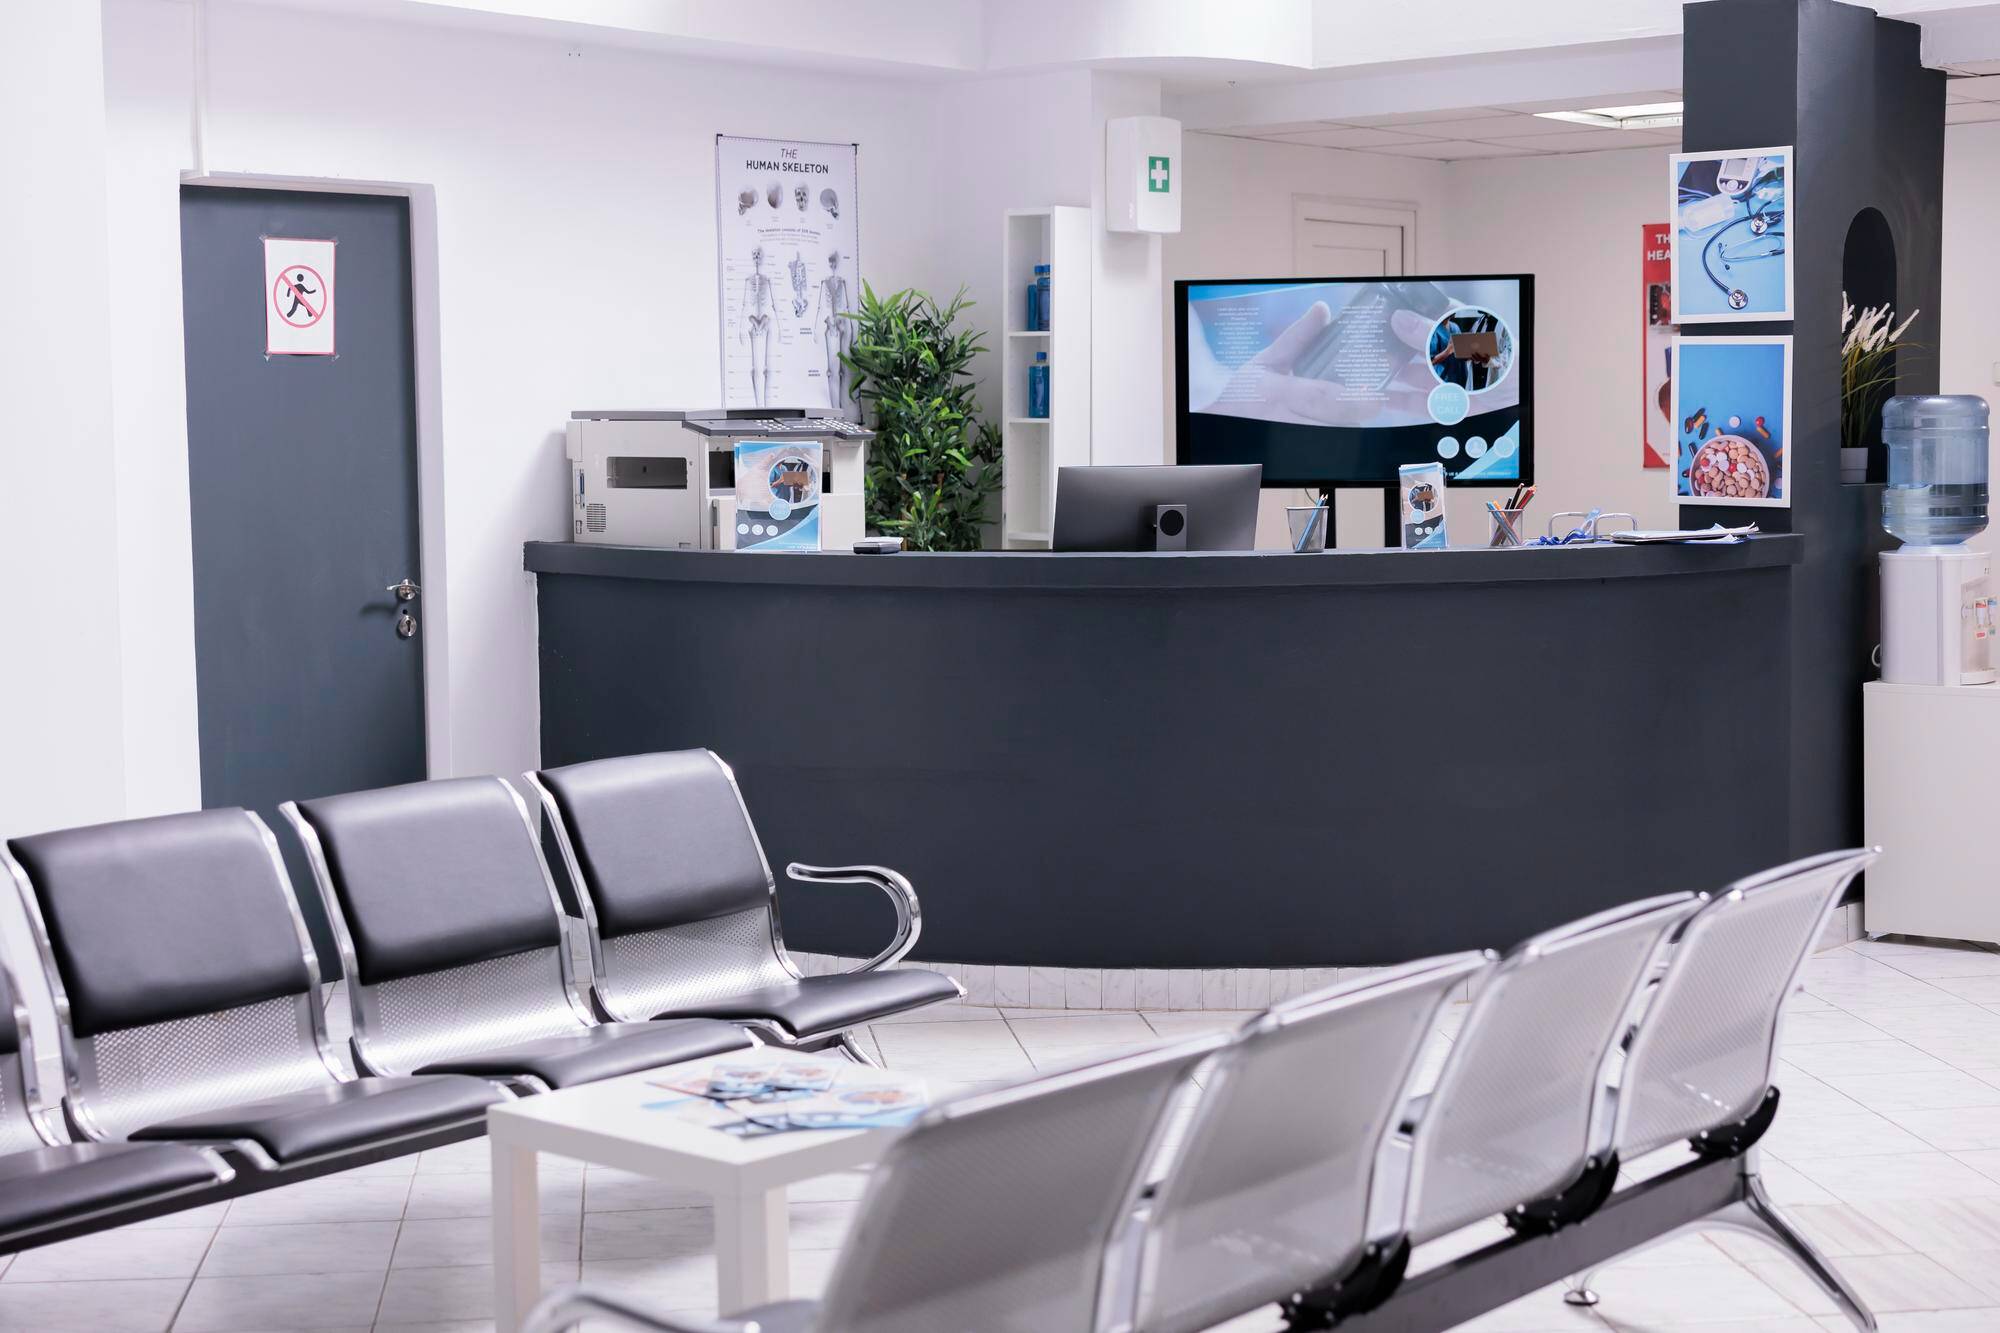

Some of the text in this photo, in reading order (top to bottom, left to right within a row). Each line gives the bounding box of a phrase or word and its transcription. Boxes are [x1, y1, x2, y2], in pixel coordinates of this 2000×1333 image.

[781, 148, 798, 159] THE
[746, 160, 829, 174] HUMAN SKELETON
[1435, 392, 1461, 401] FREE
